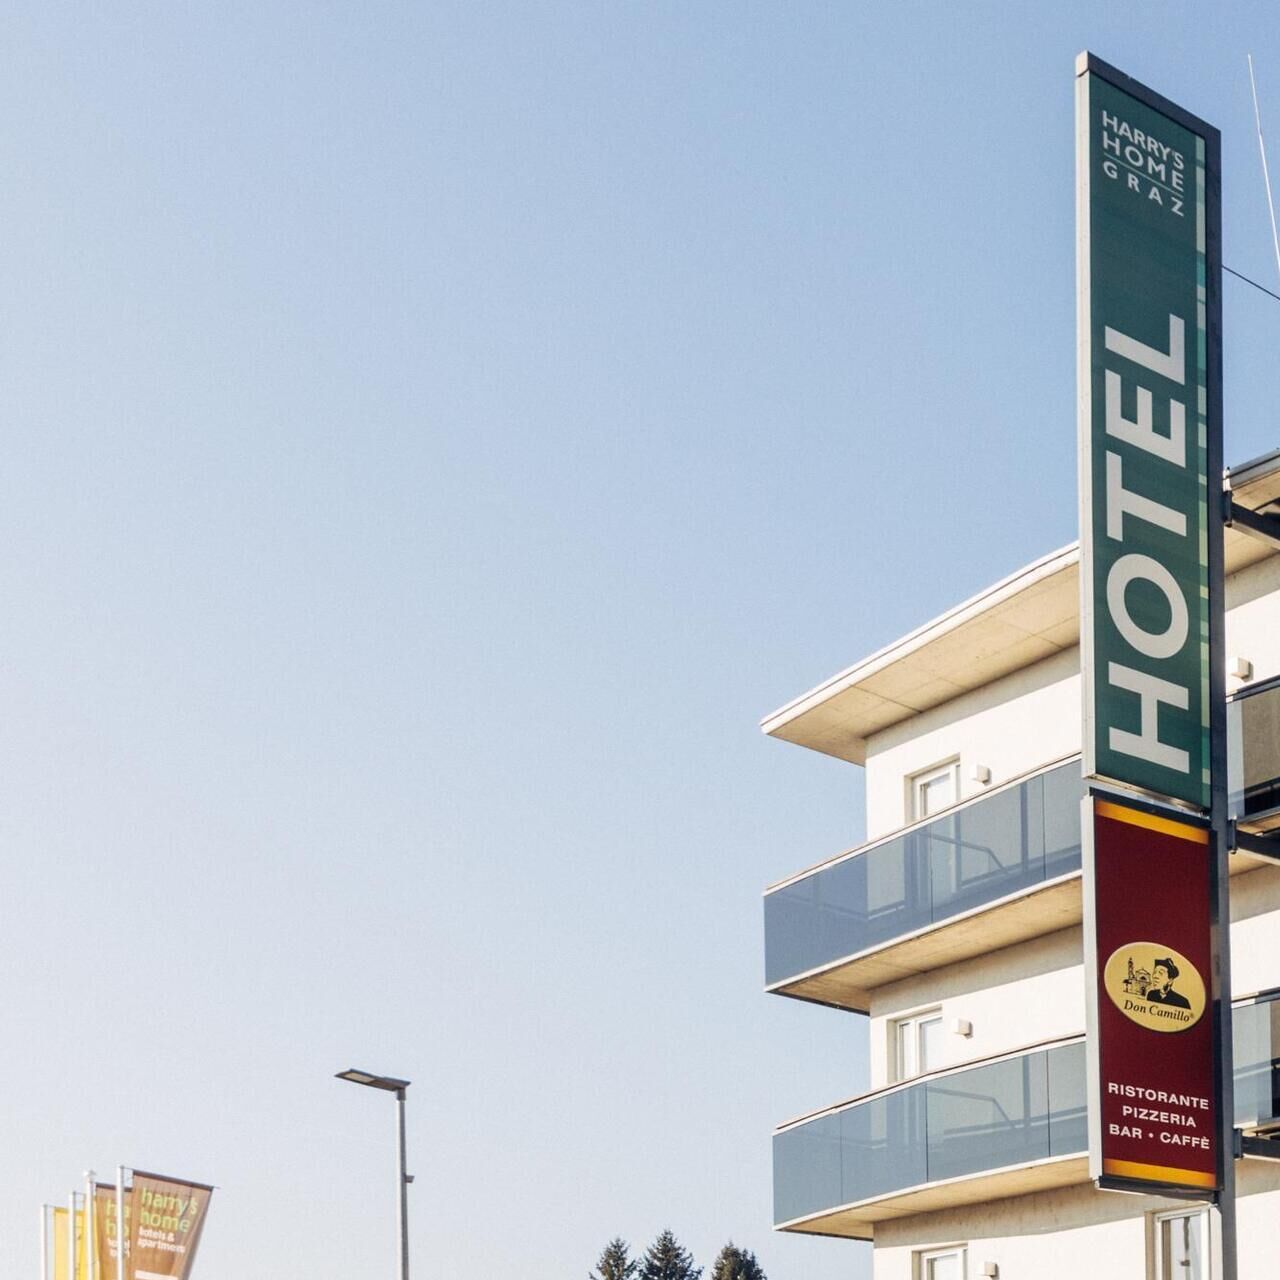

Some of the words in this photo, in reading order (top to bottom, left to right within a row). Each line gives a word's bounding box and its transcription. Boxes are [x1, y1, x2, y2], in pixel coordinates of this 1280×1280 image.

[1102, 110, 1185, 169] HARRY'S
[1103, 131, 1184, 192] HOME
[1103, 161, 1184, 217] GRAZ
[1104, 313, 1190, 774] HOTEL
[1124, 999, 1146, 1014] Don
[1108, 1083, 1209, 1110] RISTORANTE
[1122, 1105, 1197, 1128] PIZZERIA
[1109, 1124, 1142, 1139] BAR
[141, 1187, 199, 1216] harry's
[140, 1206, 191, 1233] home
[167, 1232, 175, 1242] &
